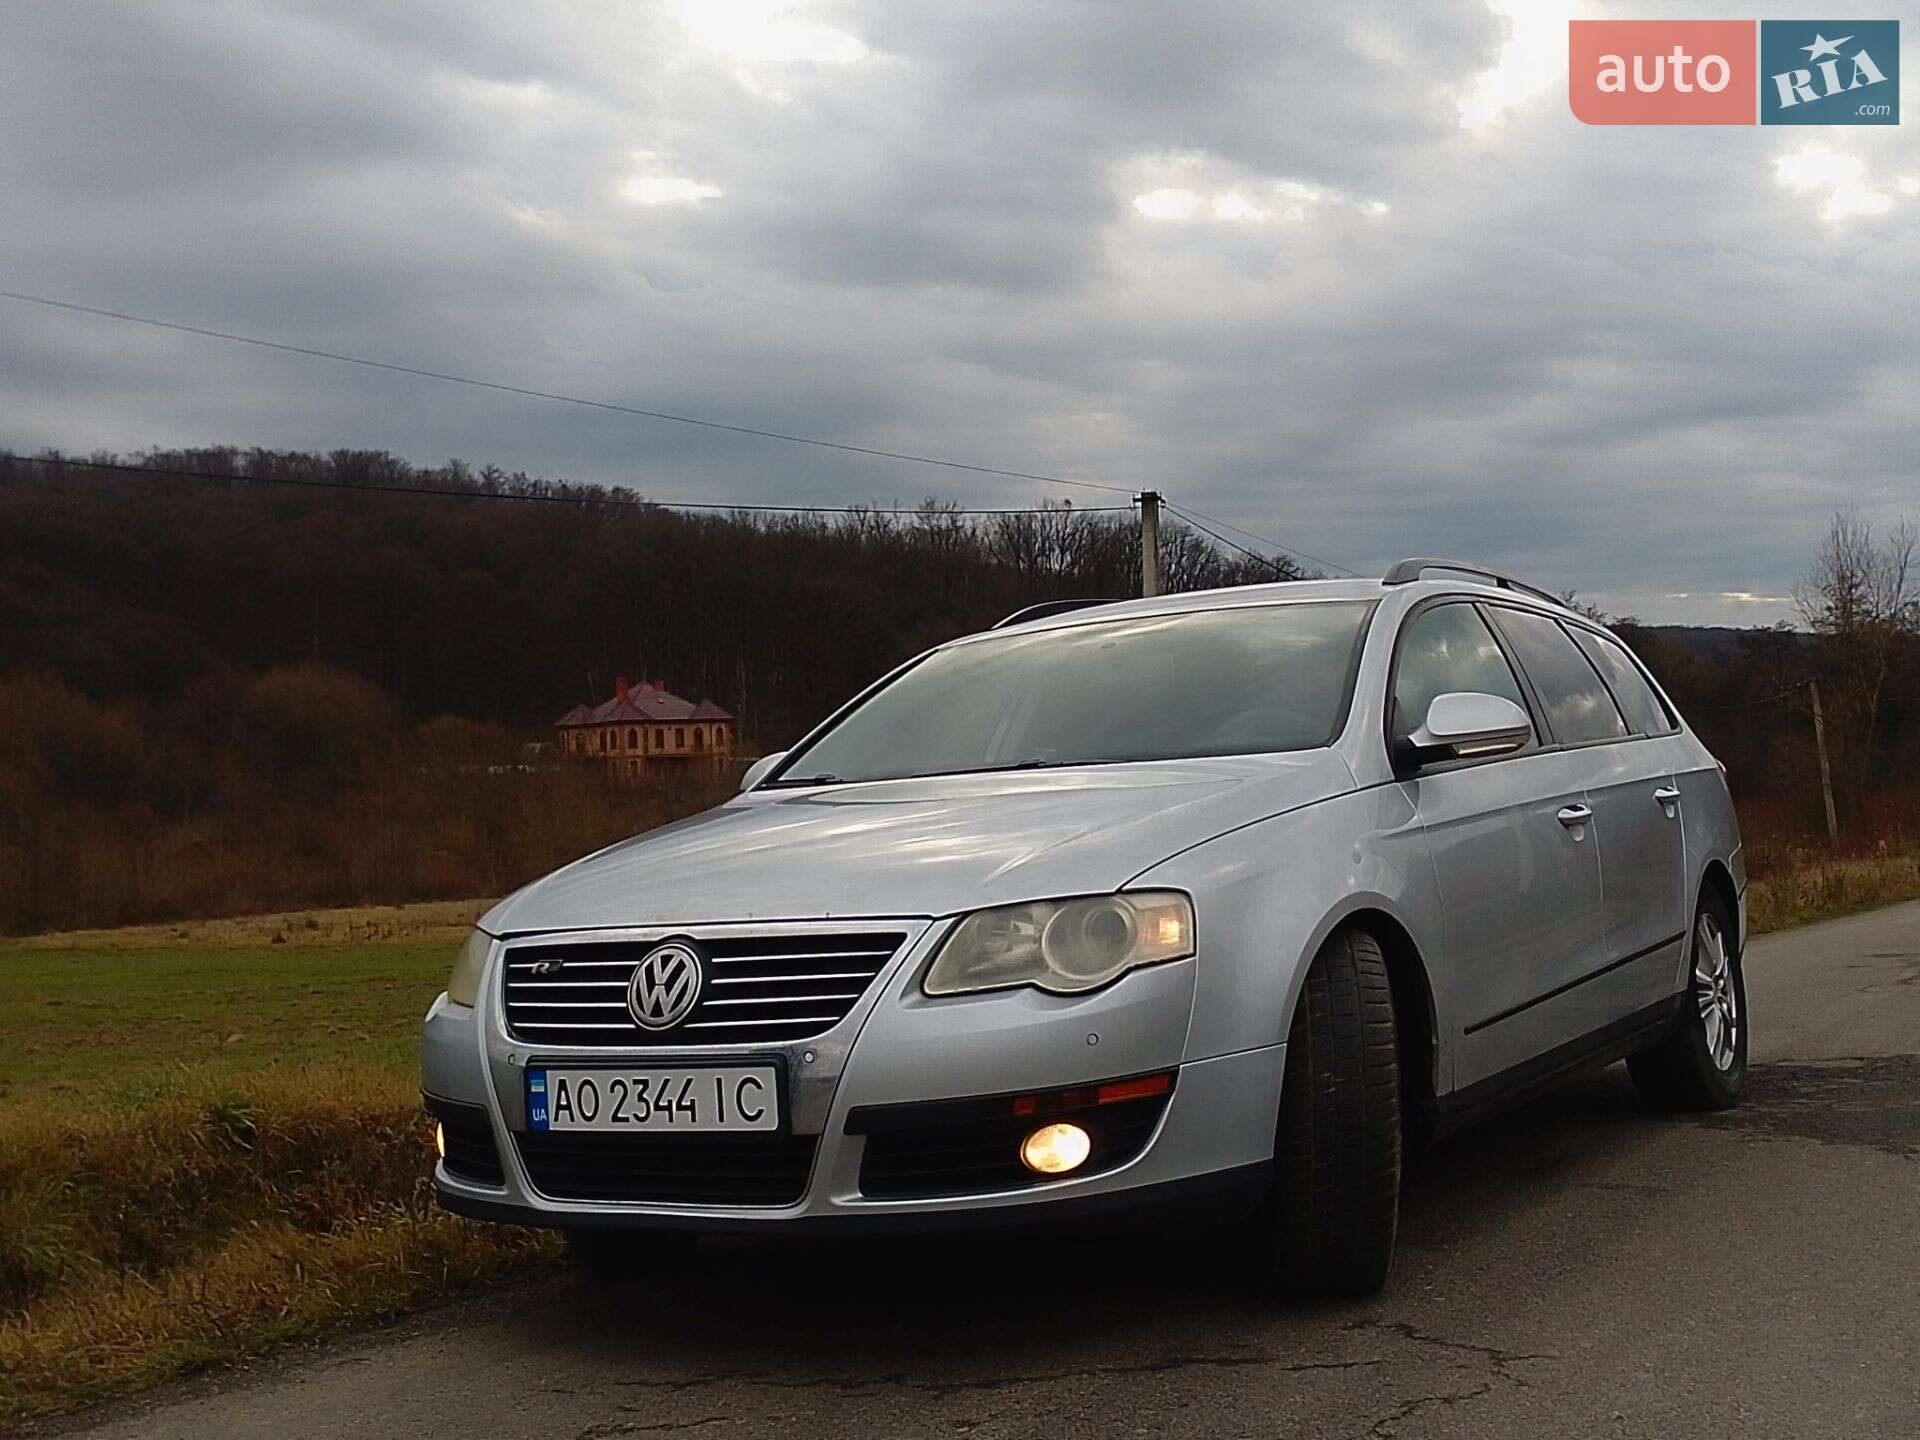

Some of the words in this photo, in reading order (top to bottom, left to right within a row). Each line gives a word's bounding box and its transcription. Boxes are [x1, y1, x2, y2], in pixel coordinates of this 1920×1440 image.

[632, 949, 698, 1023] VW
[532, 1110, 548, 1121] UA
[553, 1078, 600, 1122] AO
[609, 1077, 697, 1123] 2344
[715, 1076, 765, 1123] IC
